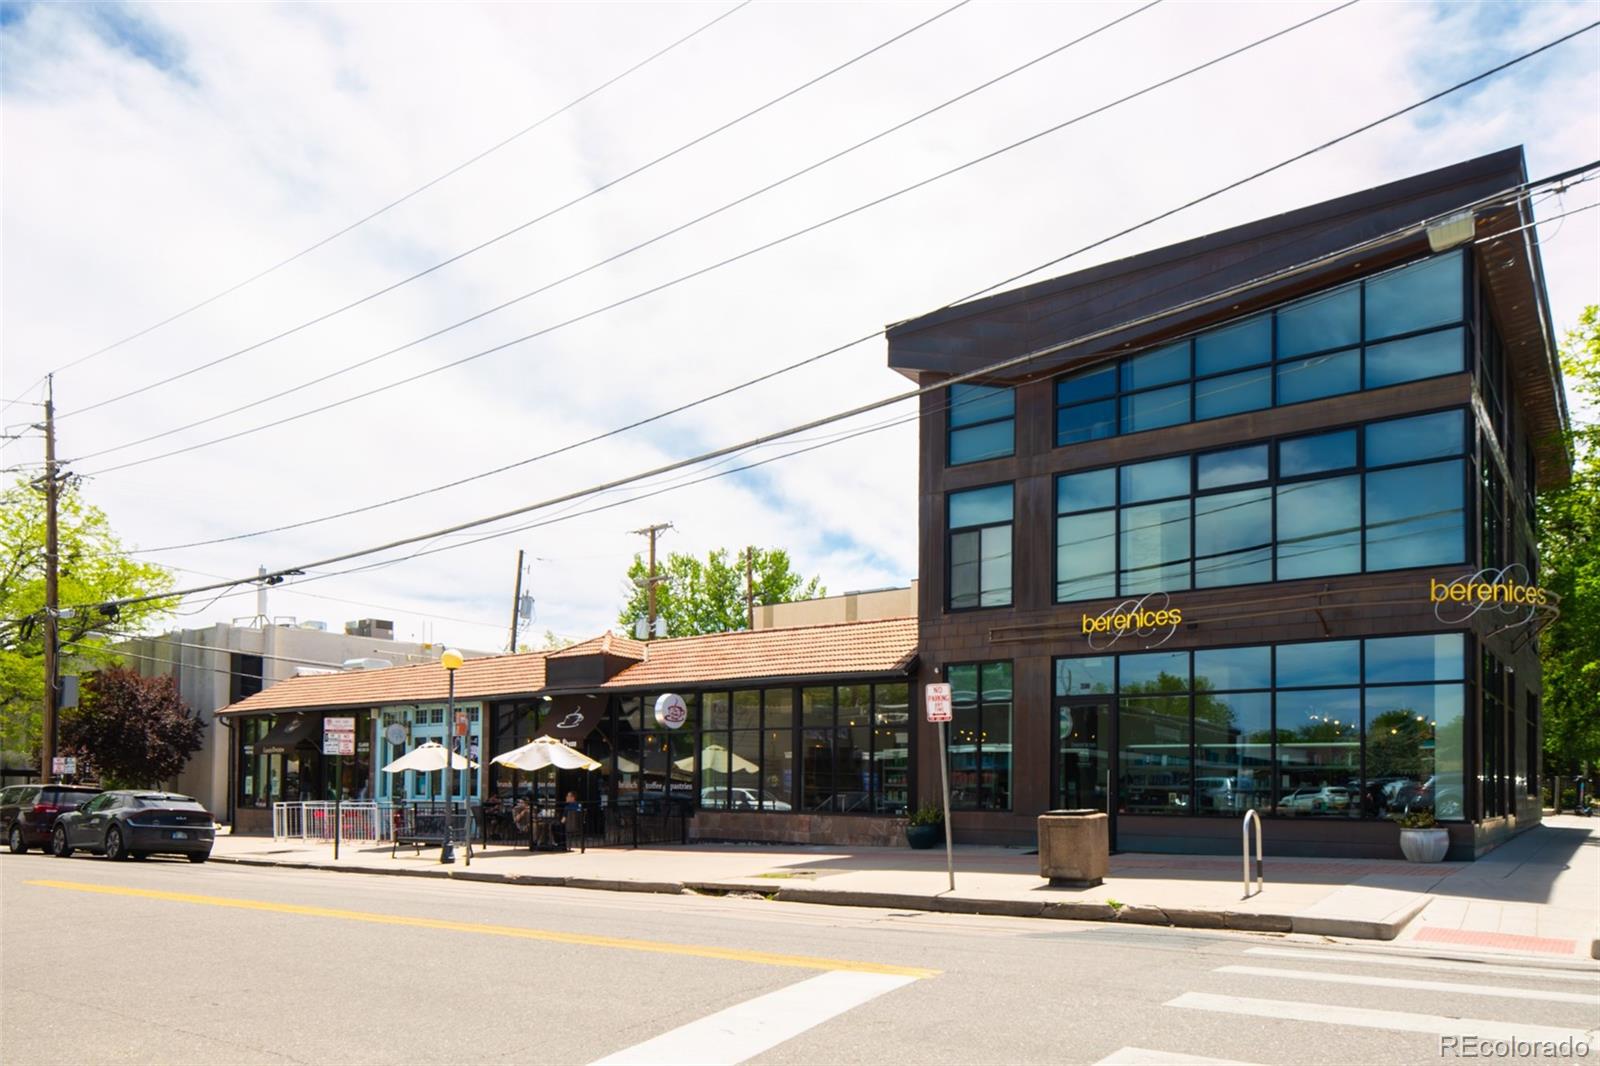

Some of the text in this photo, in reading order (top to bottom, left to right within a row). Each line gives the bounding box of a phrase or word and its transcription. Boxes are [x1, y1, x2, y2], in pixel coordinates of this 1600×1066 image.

[1430, 578, 1547, 605] berenices
[1081, 607, 1182, 634] berenices
[670, 782, 693, 791] pastries
